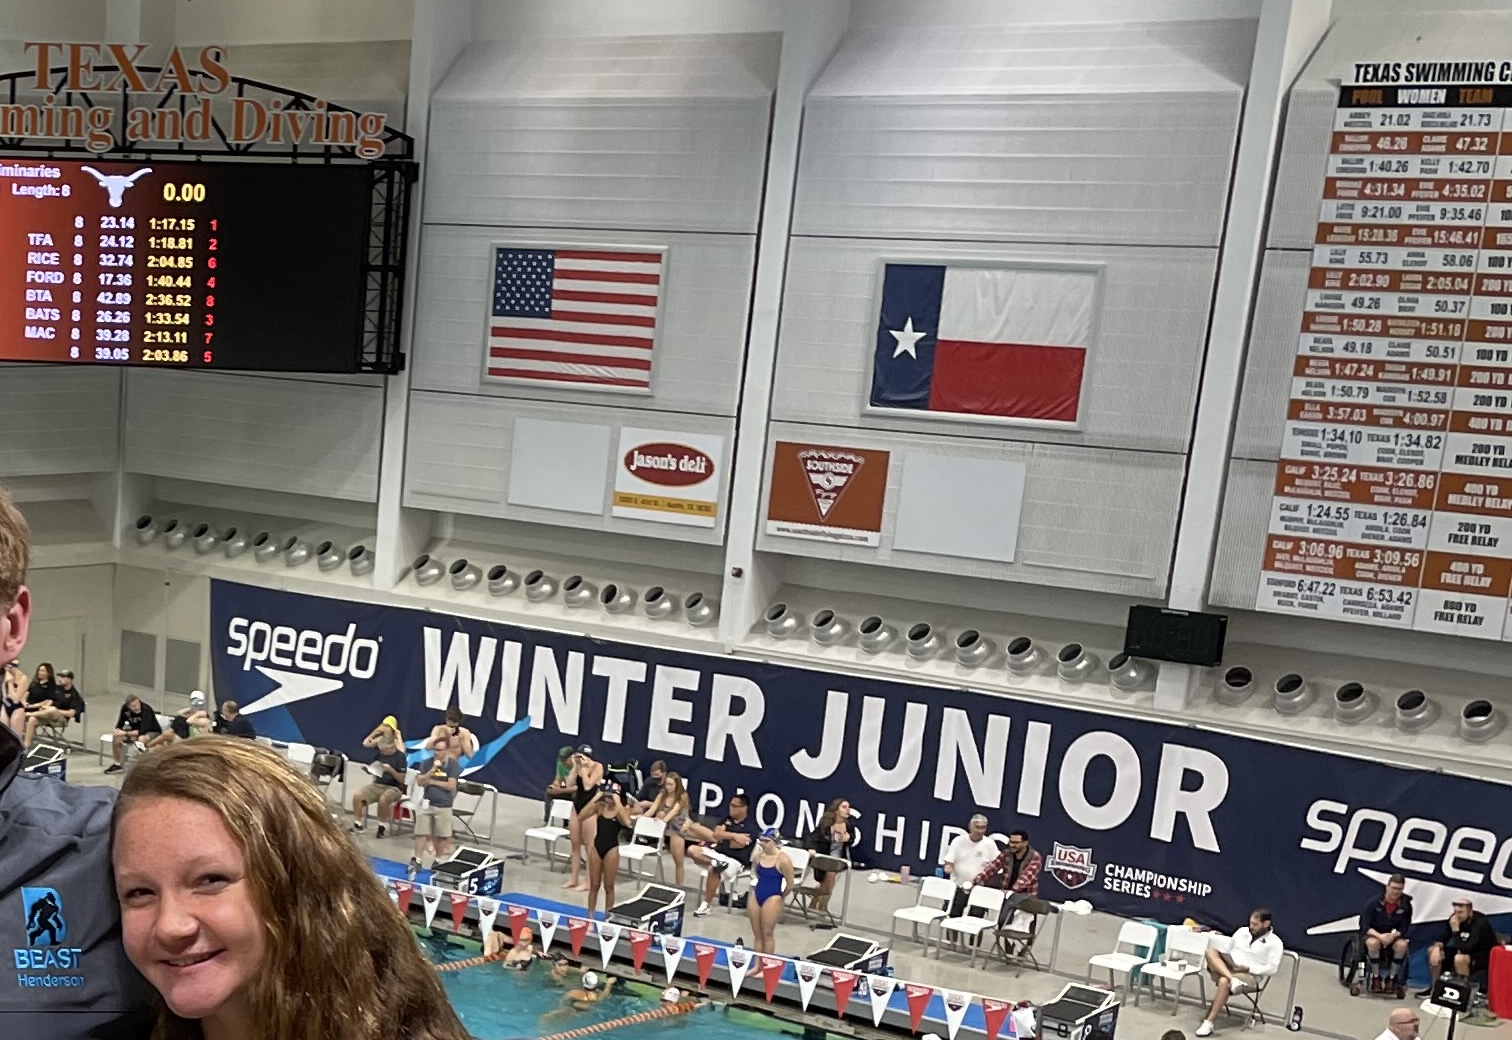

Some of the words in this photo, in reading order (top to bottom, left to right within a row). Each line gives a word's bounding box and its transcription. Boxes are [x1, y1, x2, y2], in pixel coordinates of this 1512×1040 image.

[24, 41, 231, 95] TEXAS
[1354, 62, 1402, 83] TEXAS
[1404, 62, 1496, 82] SWIMMING
[1397, 88, 1447, 105] WOMEN
[126, 95, 212, 144] and
[231, 97, 389, 161] Diving
[1379, 113, 1411, 127] 21.02
[1460, 113, 1492, 127] 21.73
[1456, 138, 1489, 151] 47.32
[1369, 160, 1409, 173] 1:40.26
[1448, 161, 1490, 174] 1:42.70
[11, 183, 60, 198] Length:
[163, 182, 206, 202] 0.00
[1364, 183, 1406, 197] 4:31.34
[1442, 184, 1486, 198] 4:35.02
[1361, 206, 1402, 219] 9:21.00
[1440, 208, 1482, 222] 9:35.46
[74, 216, 84, 228] 8
[100, 216, 135, 229] 23.14
[148, 217, 196, 231] 1:17.15
[210, 219, 217, 231] 1
[27, 233, 54, 246] TFA
[74, 235, 84, 247] 8
[99, 235, 135, 248] 24.12
[148, 237, 193, 250] 1:18.81
[208, 238, 218, 250] 2
[27, 252, 61, 266] RICE
[73, 253, 83, 266] 8
[99, 254, 134, 267] 32.74
[147, 255, 194, 269] 2:04.85
[207, 257, 217, 269] 6
[1358, 252, 1388, 265] 55.73
[1442, 254, 1474, 268] 58.06
[26, 270, 65, 284] FORD
[72, 272, 82, 285] 8
[98, 273, 133, 286] 17.36
[146, 275, 192, 289] 1:40.44
[206, 276, 216, 289] 4
[1426, 276, 1469, 290] 2:05.04
[25, 289, 53, 302] BTA
[72, 291, 82, 303] 8
[96, 291, 132, 305] 42.89
[145, 293, 192, 307] 2:36.52
[1434, 300, 1466, 313] 50.37
[25, 307, 61, 321] BATS
[71, 309, 81, 322] 8
[96, 310, 131, 324] 26.26
[144, 311, 190, 325] 1:33.54
[204, 314, 214, 326] 3
[24, 325, 56, 339] MAC
[70, 327, 80, 340] 8
[95, 328, 130, 342] 39.28
[143, 330, 188, 344] 2:13.11
[204, 332, 213, 344] 7
[70, 346, 80, 359] 8
[95, 347, 130, 360] 39.05
[142, 349, 189, 363] 2:03.86
[203, 351, 212, 363] 5
[1343, 341, 1373, 354] 49.18
[1425, 345, 1456, 359] 50.51
[1335, 363, 1375, 377] 1:47.24
[1331, 385, 1369, 399] 1:50.79
[1407, 390, 1447, 405] 1:52.58
[1402, 412, 1445, 427] 4:00.97
[1321, 428, 1362, 444] 1:34.10
[1394, 433, 1442, 449] 1:34.82
[630, 450, 677, 471] Jason's
[679, 455, 707, 474] deli
[1311, 465, 1358, 483] 3:25.24
[1385, 472, 1434, 490] 3:26.86
[1307, 503, 1350, 521] 1:24.55
[1354, 510, 1378, 520] TEXAS
[1382, 512, 1427, 529] 1:26.84
[1448, 533, 1469, 545] FREE
[1471, 535, 1499, 548] RELAY
[1373, 550, 1420, 567] 3:09.56
[1297, 579, 1337, 597] 6:47.22
[1339, 586, 1363, 597] TEXAS
[1367, 588, 1412, 606] 6:53.42
[226, 615, 382, 680] speedo
[422, 625, 767, 769] WINTER
[790, 689, 1231, 855] JUNIOR
[1057, 849, 1085, 865] USA
[468, 878, 478, 895] 5
[1103, 877, 1152, 899] SERIES
[1104, 863, 1212, 897] CHAMPIONSHIP
[14, 948, 83, 969] BEAST
[18, 972, 84, 988] Henderson
